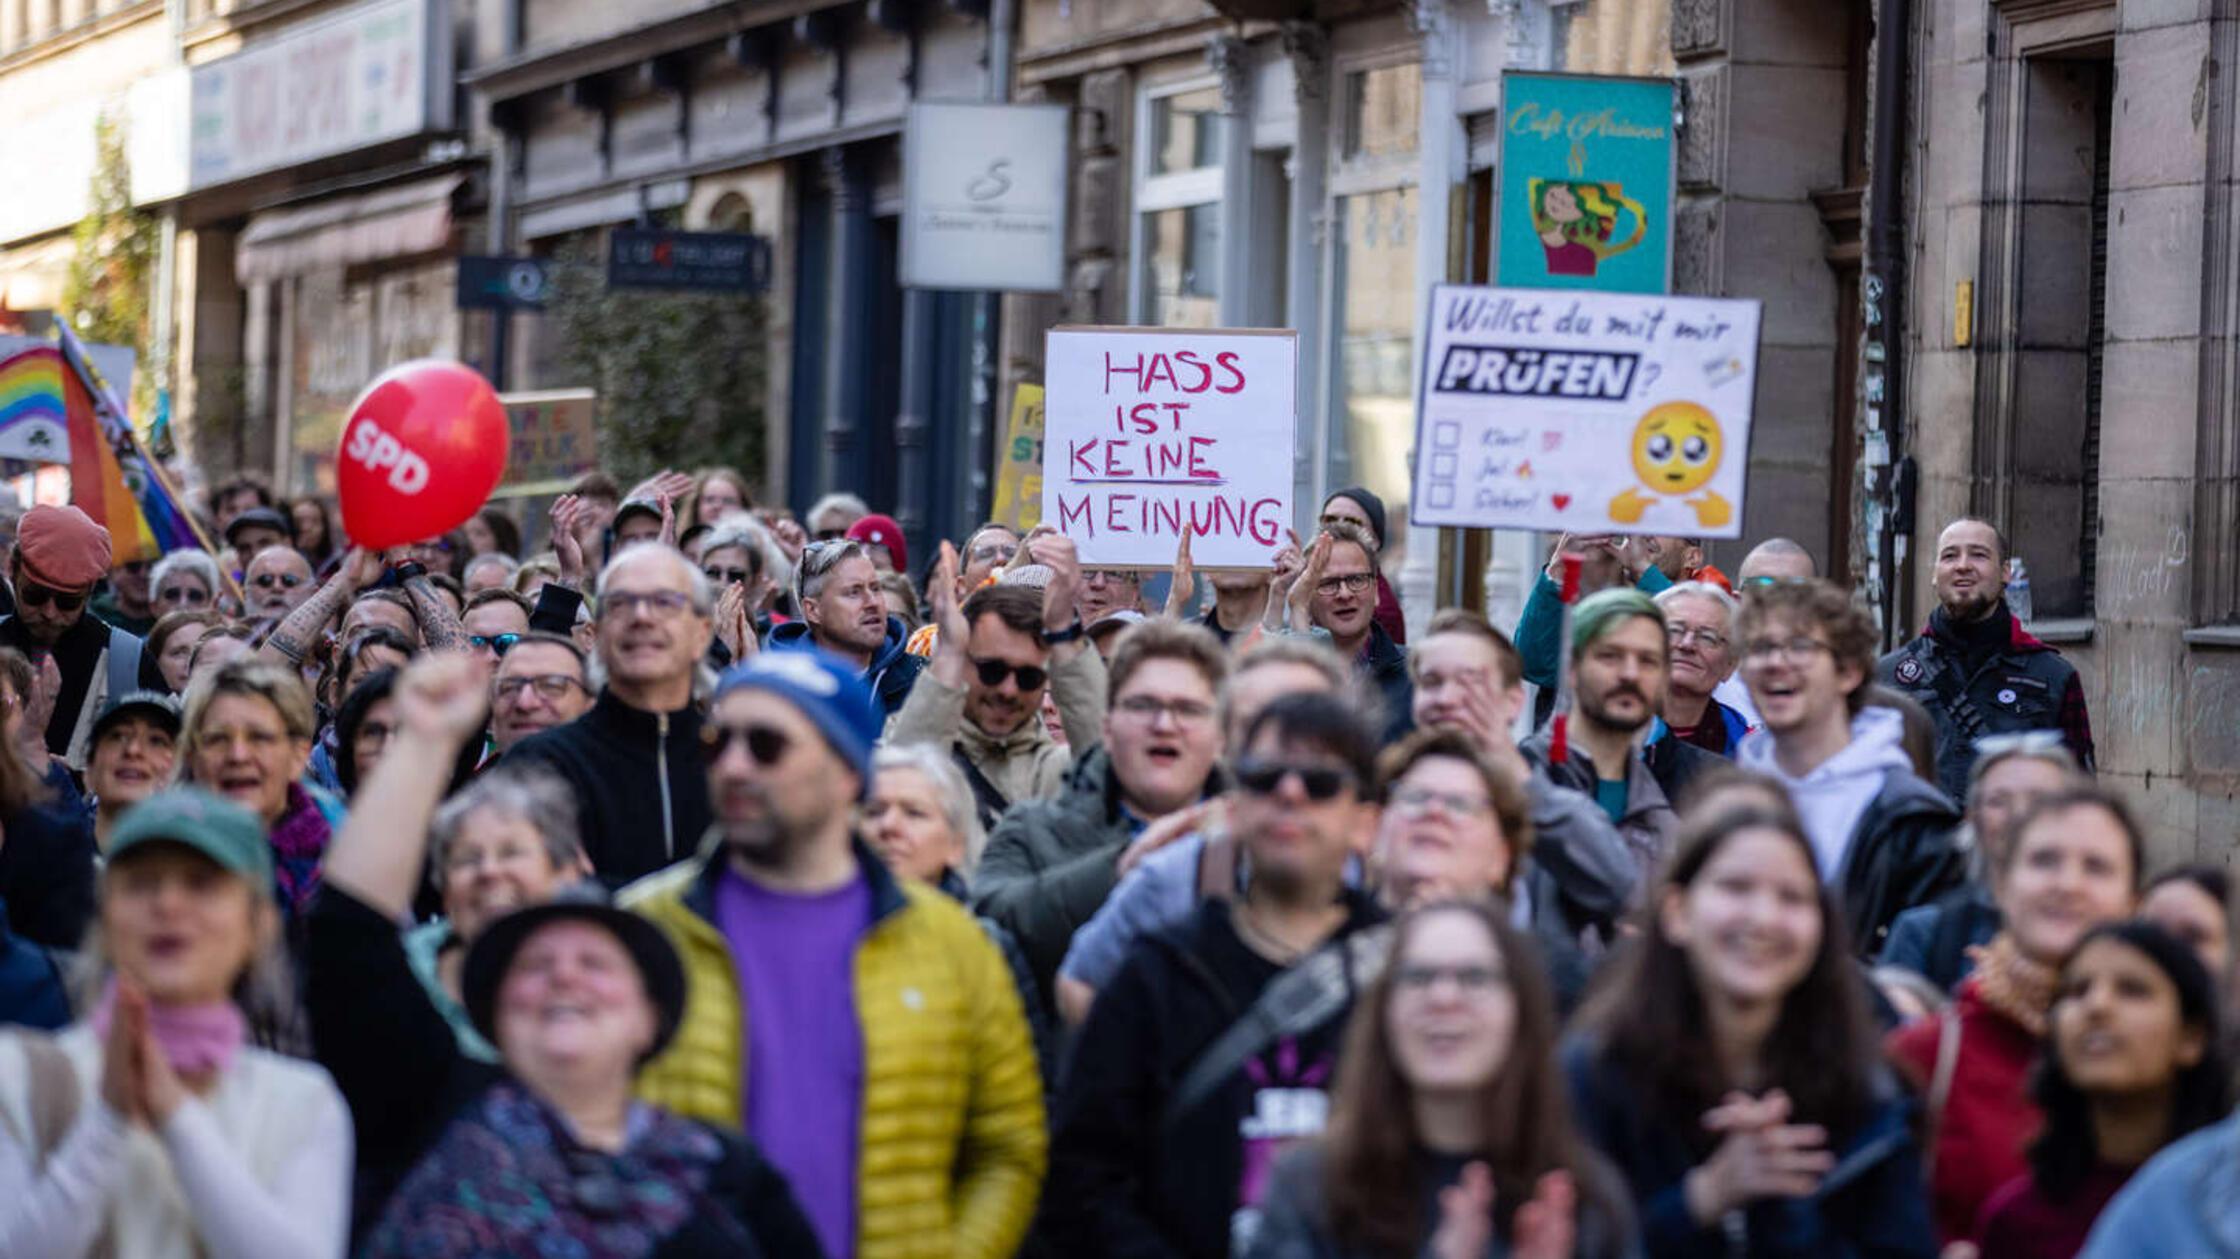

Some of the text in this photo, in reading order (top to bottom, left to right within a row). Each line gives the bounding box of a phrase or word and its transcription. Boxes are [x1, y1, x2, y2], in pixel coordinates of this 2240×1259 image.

[1446, 296, 1731, 342] Willst du mit mir
[1105, 351, 1246, 394] HASS
[1117, 402, 1191, 434] IST
[347, 417, 430, 496] SPD
[1070, 436, 1221, 479] KEINE
[1058, 493, 1282, 546] MEINUNG
